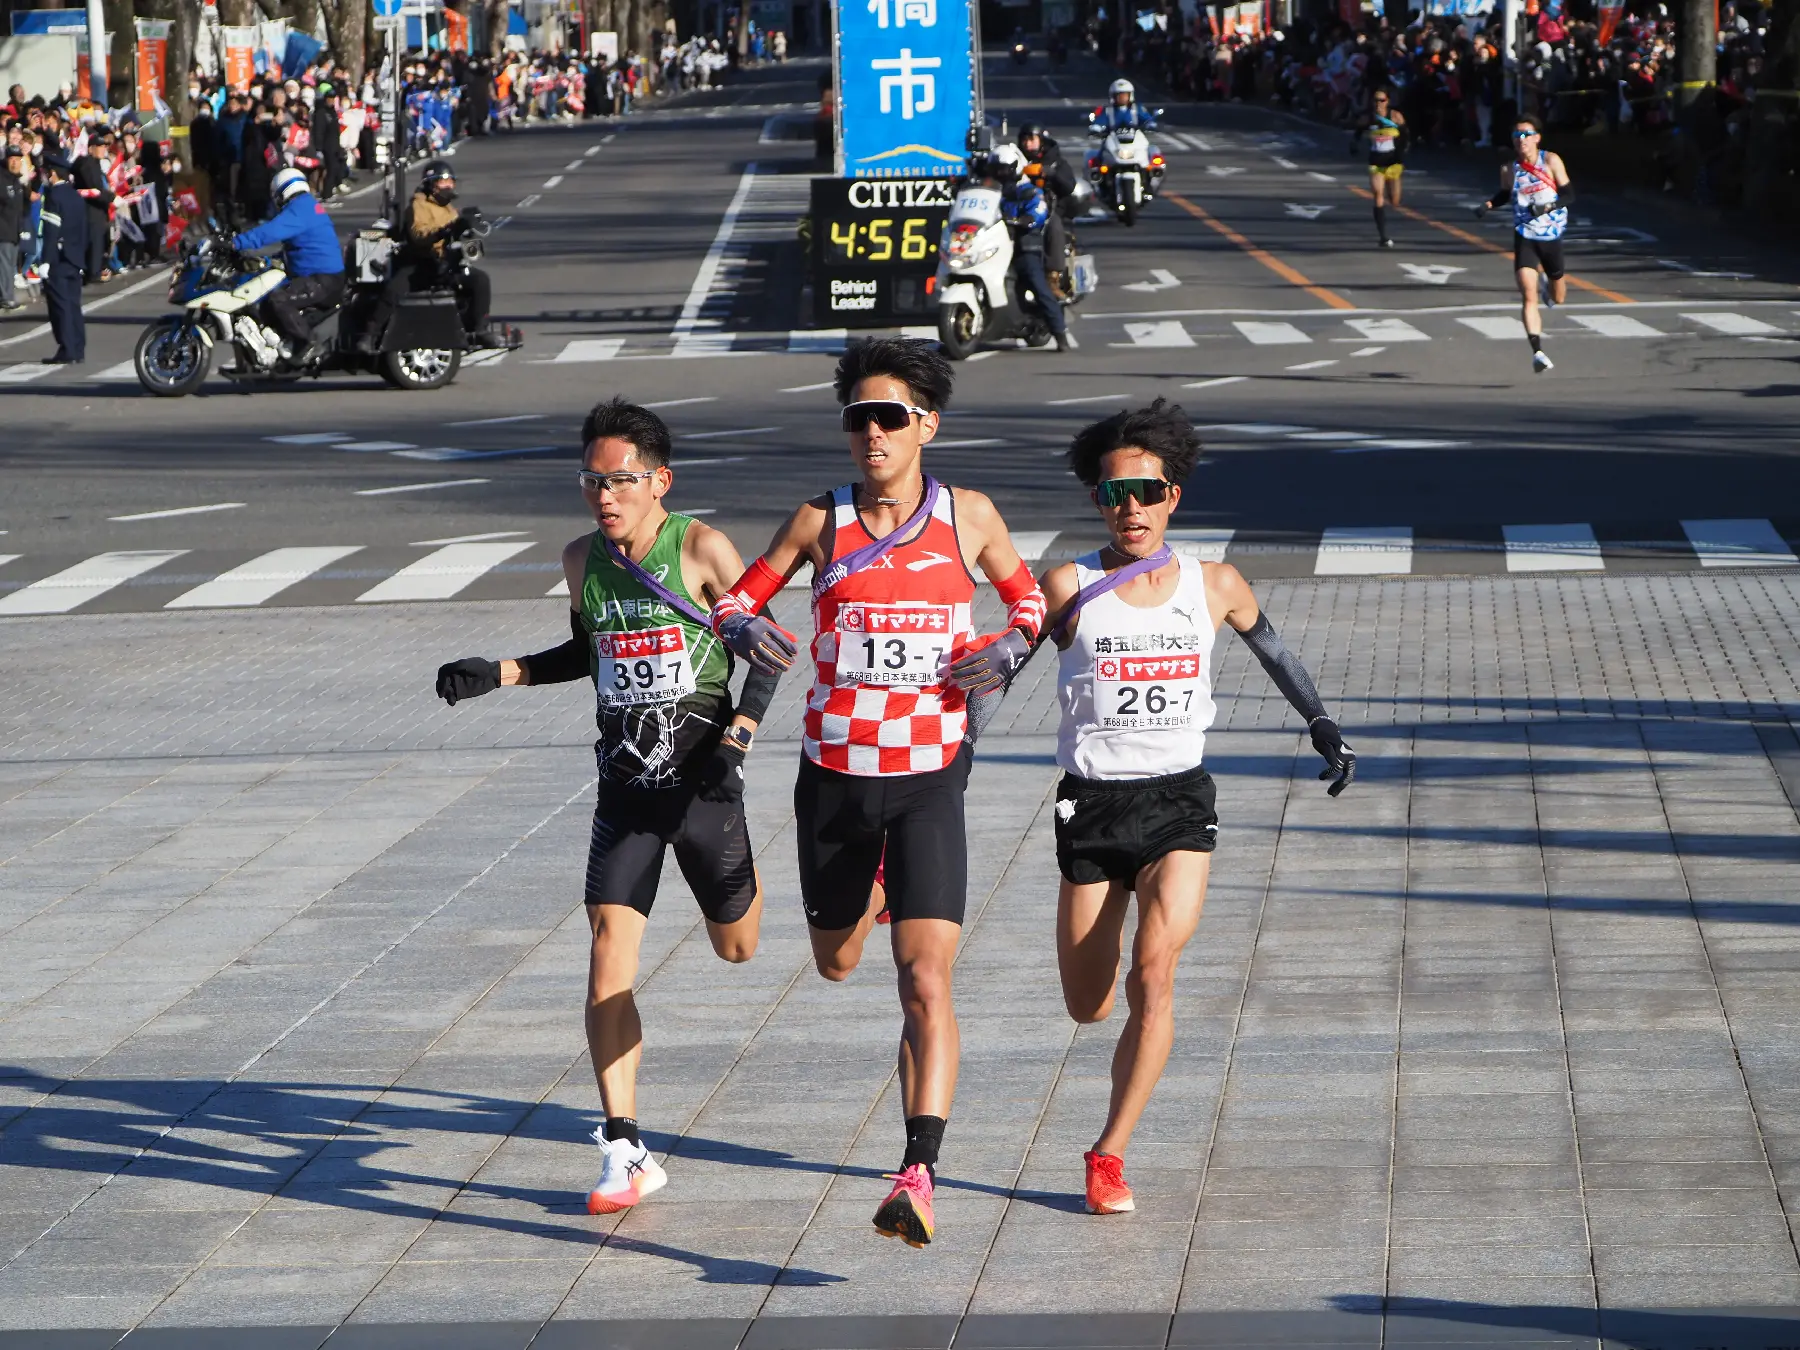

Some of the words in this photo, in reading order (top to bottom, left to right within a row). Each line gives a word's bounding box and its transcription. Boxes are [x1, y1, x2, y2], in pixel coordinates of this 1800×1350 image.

[855, 167, 926, 178] MAEBASHI
[931, 165, 964, 176] CITY
[848, 180, 955, 208] CITIZE
[960, 197, 989, 211] TBS
[831, 279, 877, 295] Behind
[831, 294, 877, 311] Leader
[869, 612, 945, 628] ヤマザキ
[612, 633, 678, 653] ヤマザキ
[1094, 633, 1199, 654] 埼玉医科大学
[862, 637, 944, 670] 13-7
[613, 659, 682, 691] 39-7
[1125, 659, 1196, 677] ヤマザキ
[1116, 685, 1194, 715] 26-7
